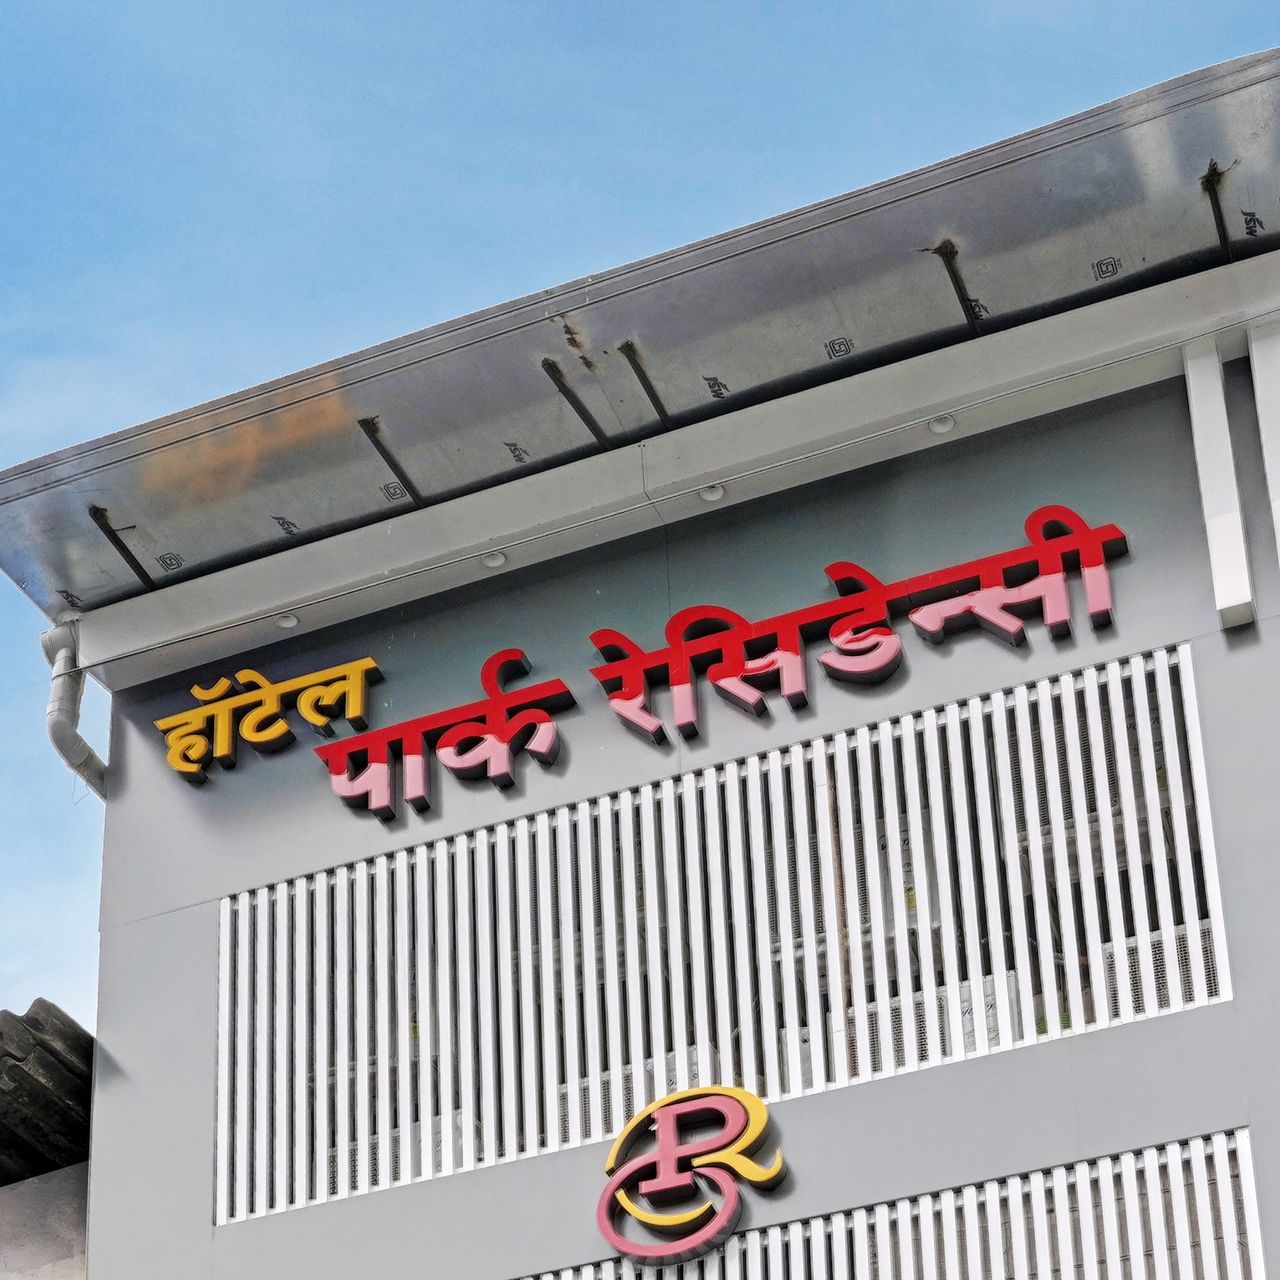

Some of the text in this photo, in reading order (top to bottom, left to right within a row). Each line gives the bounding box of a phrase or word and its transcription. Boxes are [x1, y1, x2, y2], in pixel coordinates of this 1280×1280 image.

[154, 504, 1128, 816] हॉटेल पार्क रेसिडेन्सी
